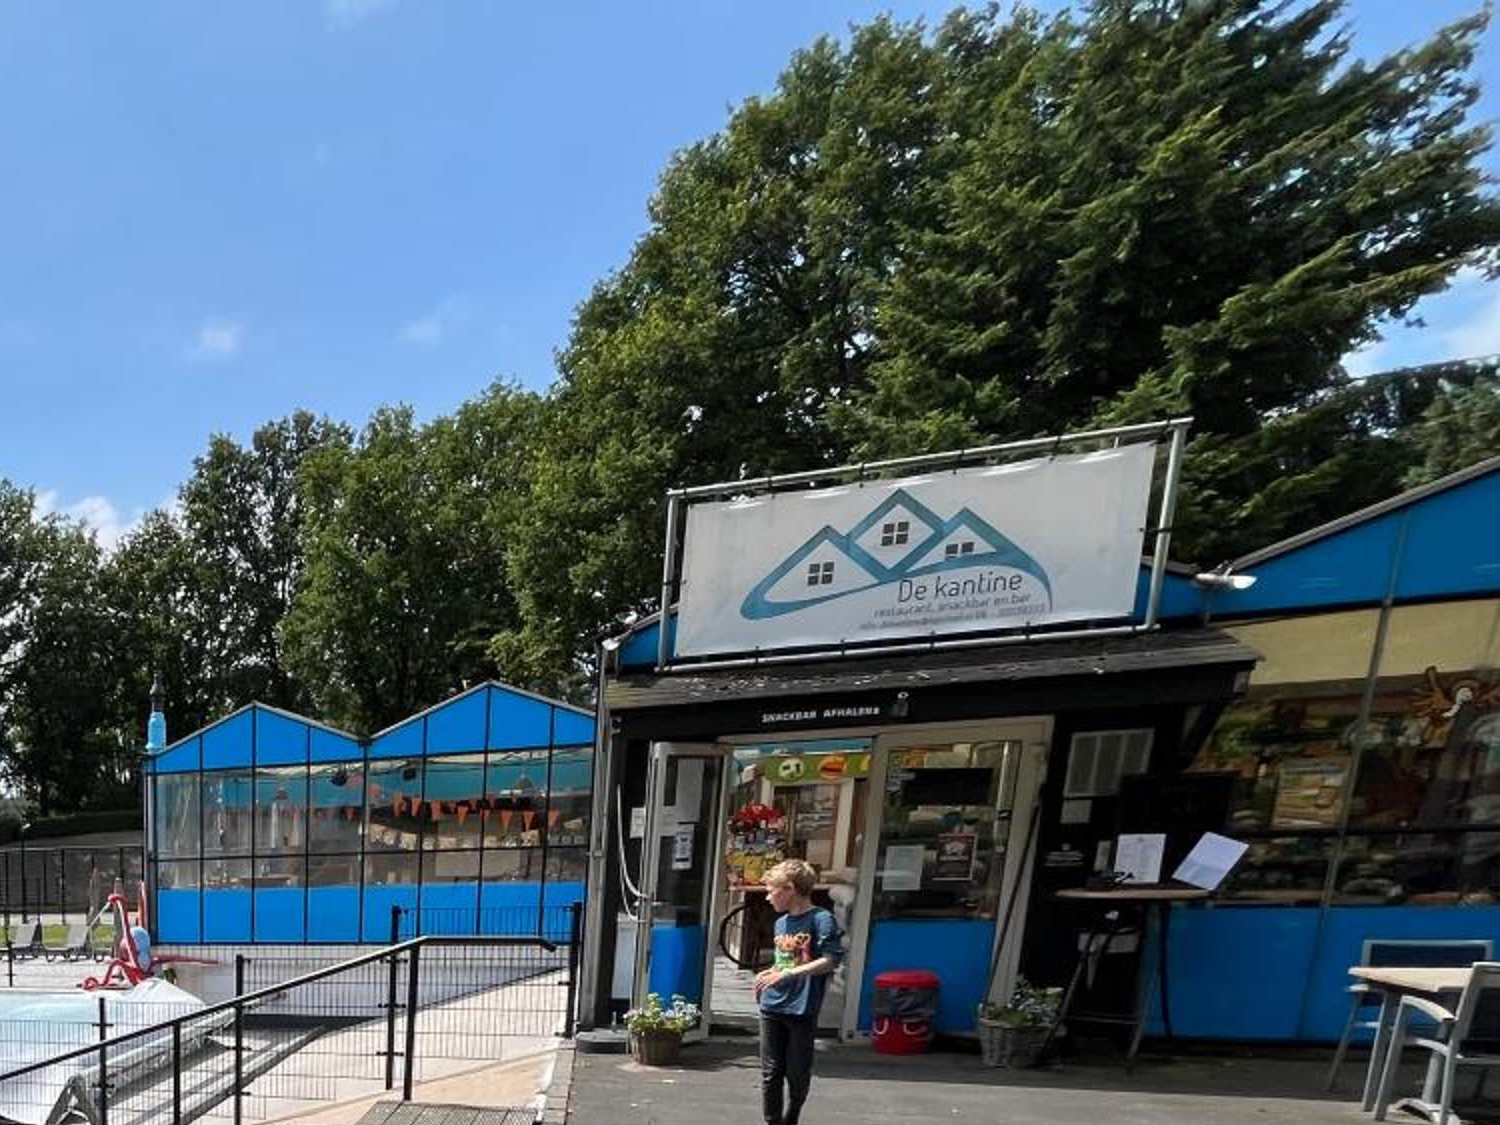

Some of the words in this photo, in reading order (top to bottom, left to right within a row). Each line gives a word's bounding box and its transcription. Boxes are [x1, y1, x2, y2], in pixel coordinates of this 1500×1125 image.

[898, 579, 927, 602] De
[935, 571, 1022, 598] kantine
[761, 710, 817, 723] SNACKBAR
